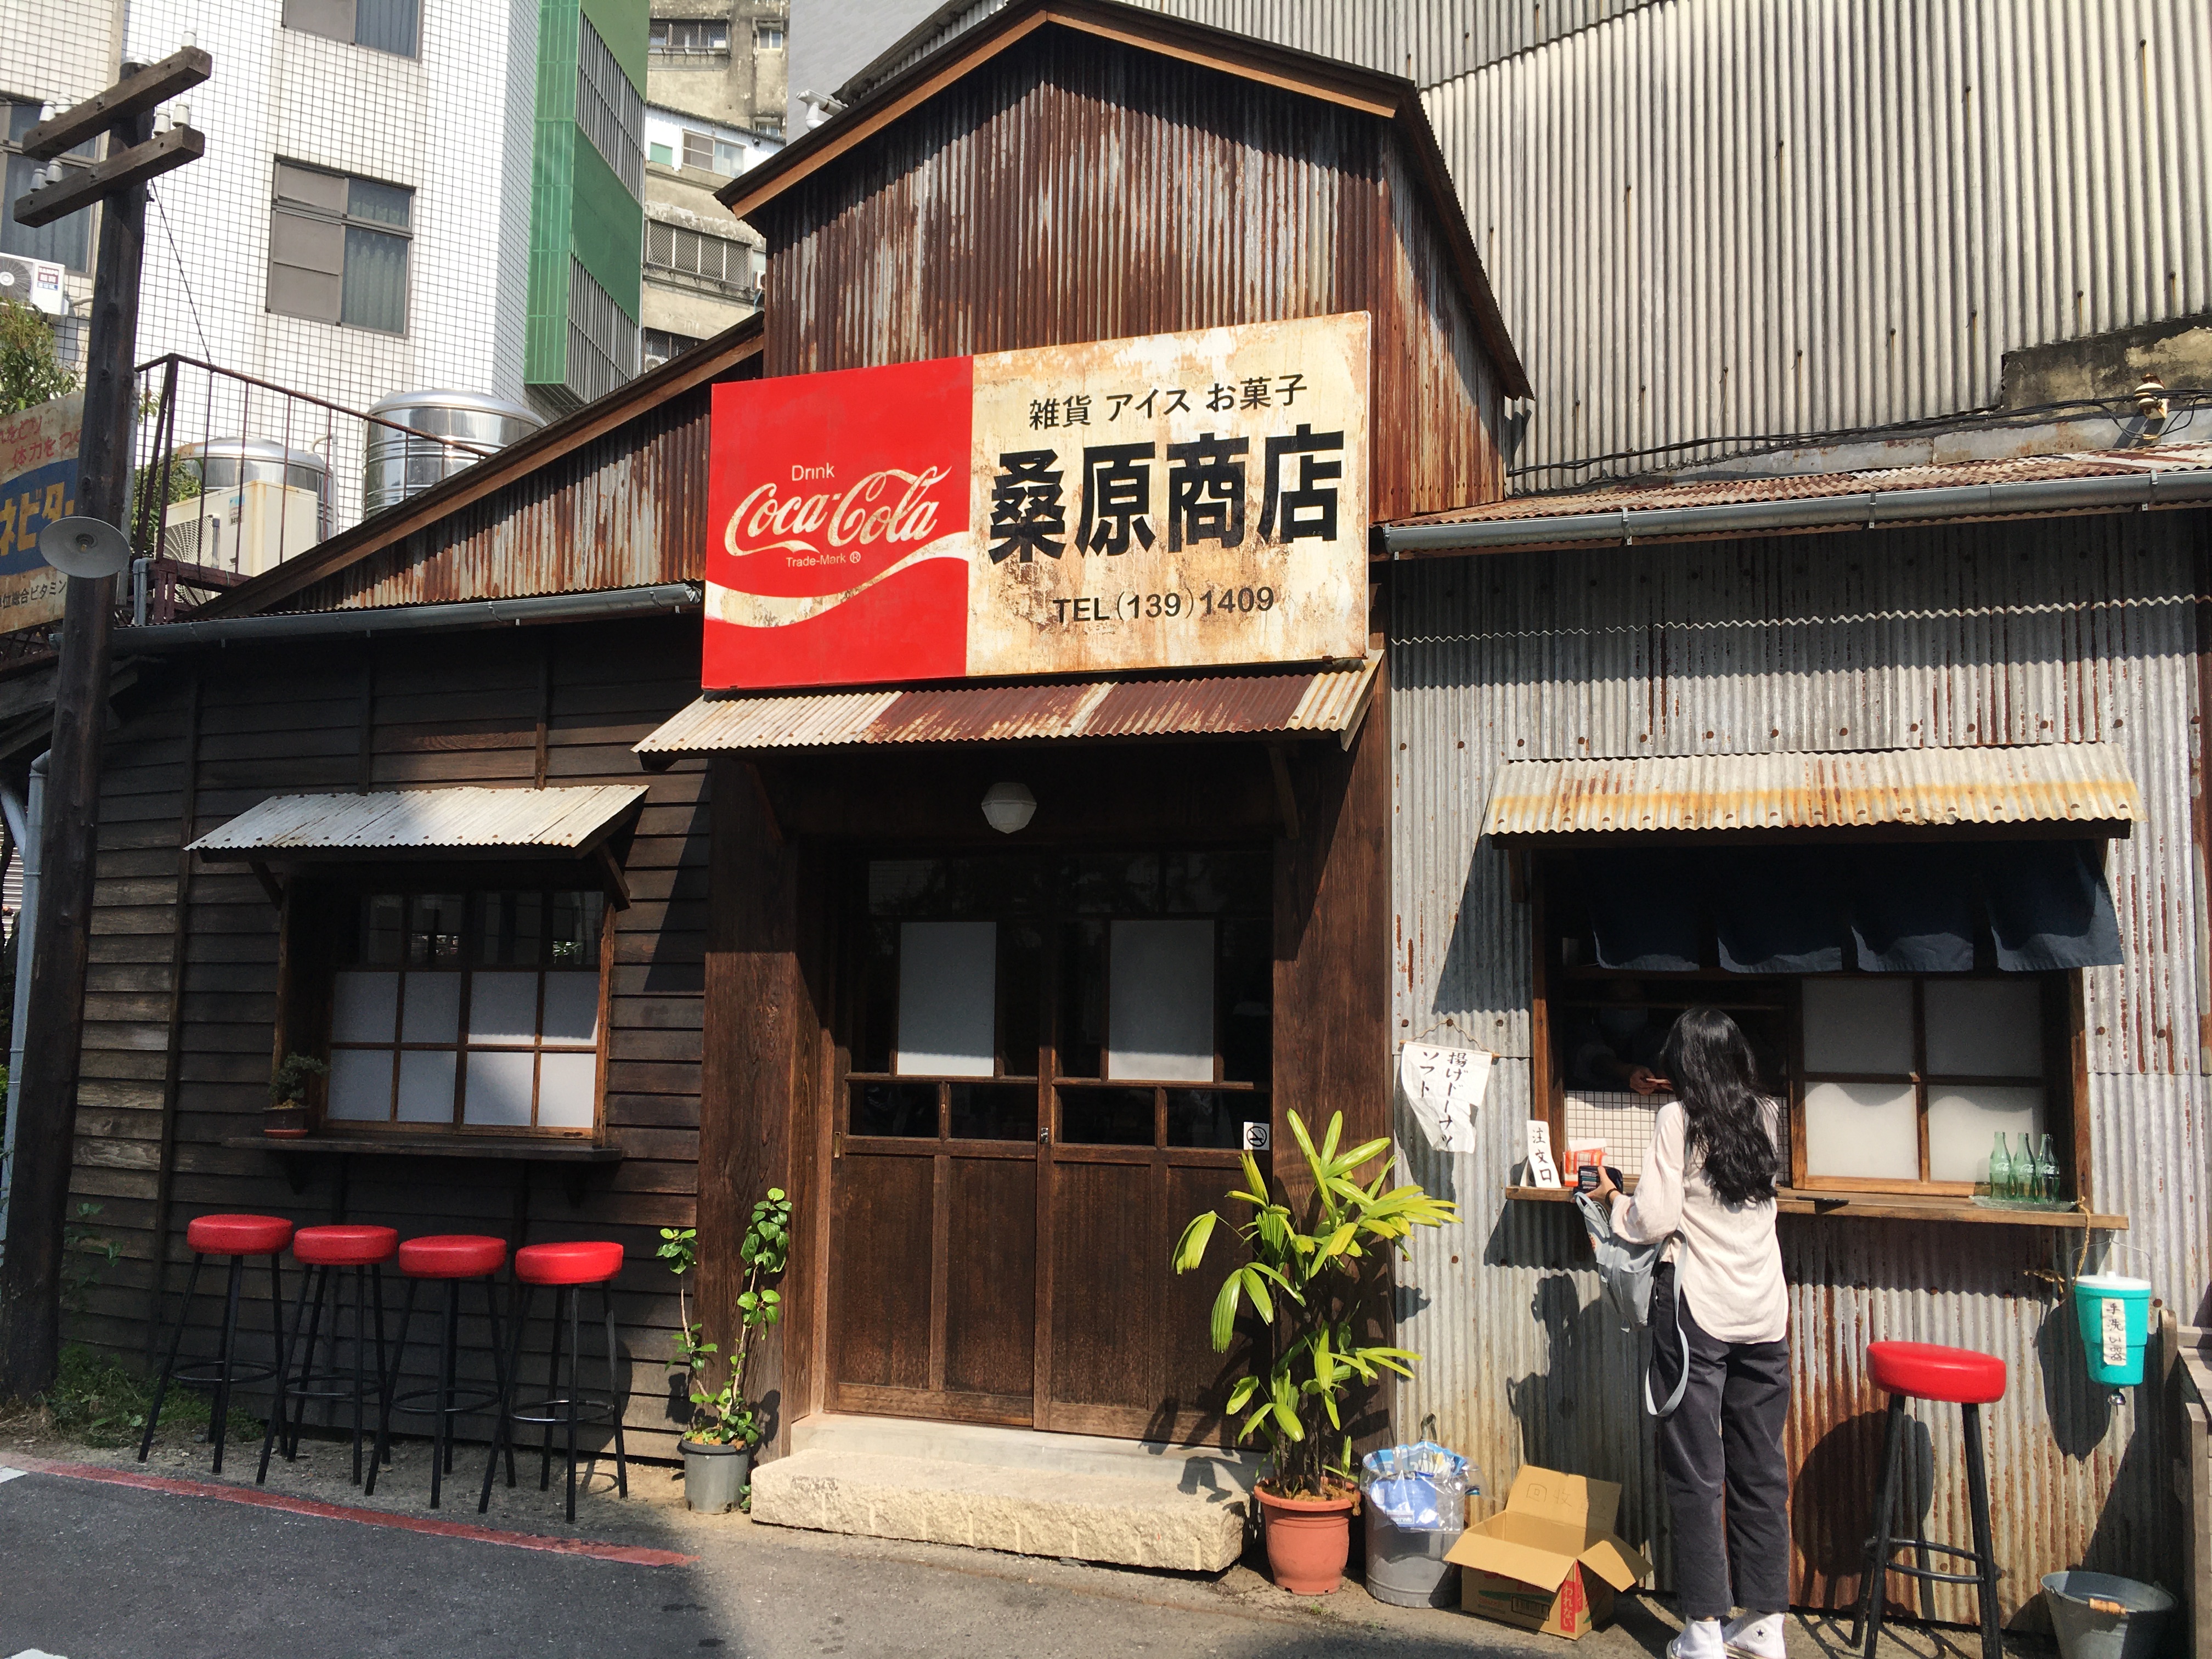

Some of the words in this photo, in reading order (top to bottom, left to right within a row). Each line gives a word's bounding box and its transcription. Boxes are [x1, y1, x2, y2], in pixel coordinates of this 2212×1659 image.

[1029, 394, 1092, 430] 雑貨
[1106, 388, 1190, 421] アイス
[1205, 374, 1307, 413] お菓子
[792, 462, 834, 481] Drink
[988, 424, 1345, 567] 桑原商店
[725, 466, 952, 556] Coca-Cola
[786, 555, 847, 568] Trade-Mark
[1419, 1051, 1440, 1098] ソフト
[1532, 1127, 1552, 1183] 注文口
[2106, 1302, 2126, 1361] 手洗い器
[1564, 1584, 1573, 1627] われない
